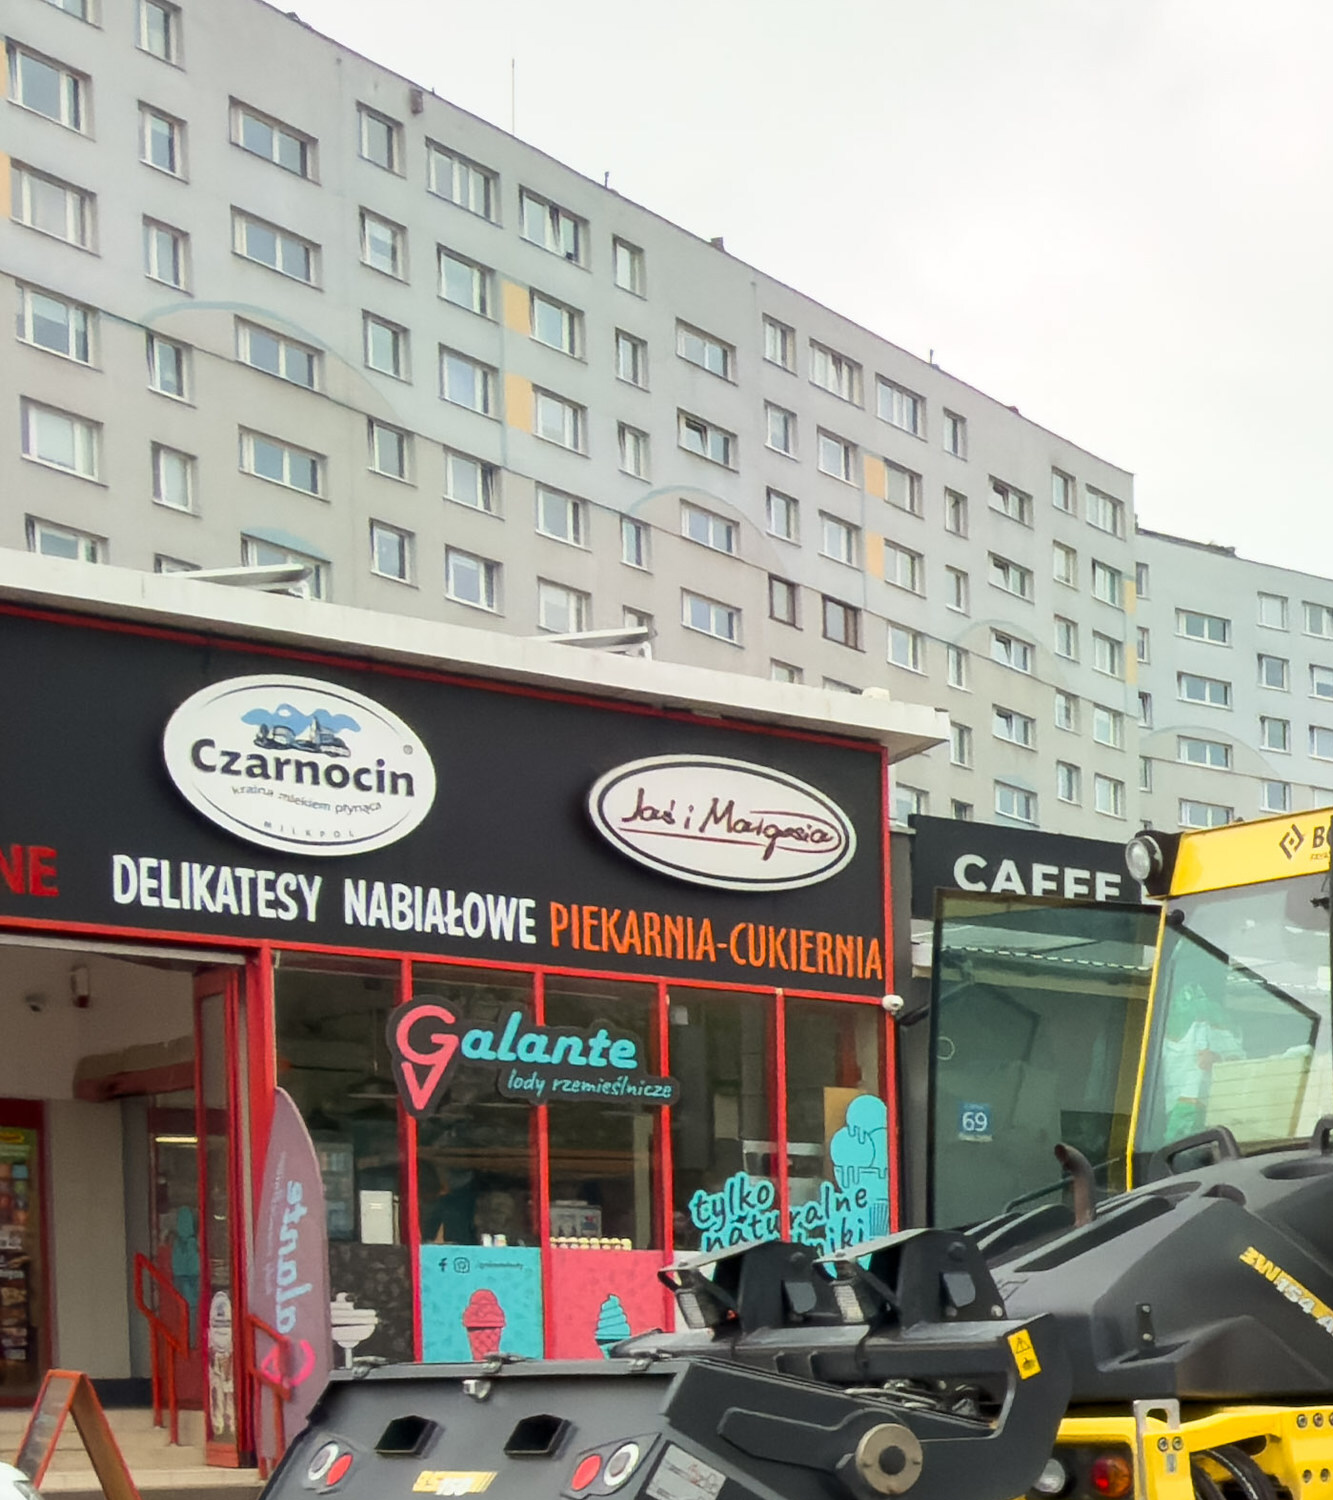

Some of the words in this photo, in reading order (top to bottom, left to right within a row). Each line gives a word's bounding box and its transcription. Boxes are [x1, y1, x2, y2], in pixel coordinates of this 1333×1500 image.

[191, 739, 415, 797] Czarnocin
[684, 805, 694, 830] i
[112, 854, 322, 922] DELIKATESY
[344, 879, 536, 943] NABIAŁOWE
[549, 901, 883, 980] PIEKARNIA-CUKIERNIA
[396, 1004, 638, 1110] Galante
[507, 1068, 546, 1097] lody
[552, 1075, 672, 1099] rzemieślnicze
[963, 1111, 987, 1131] 69
[696, 1177, 770, 1230] tylko
